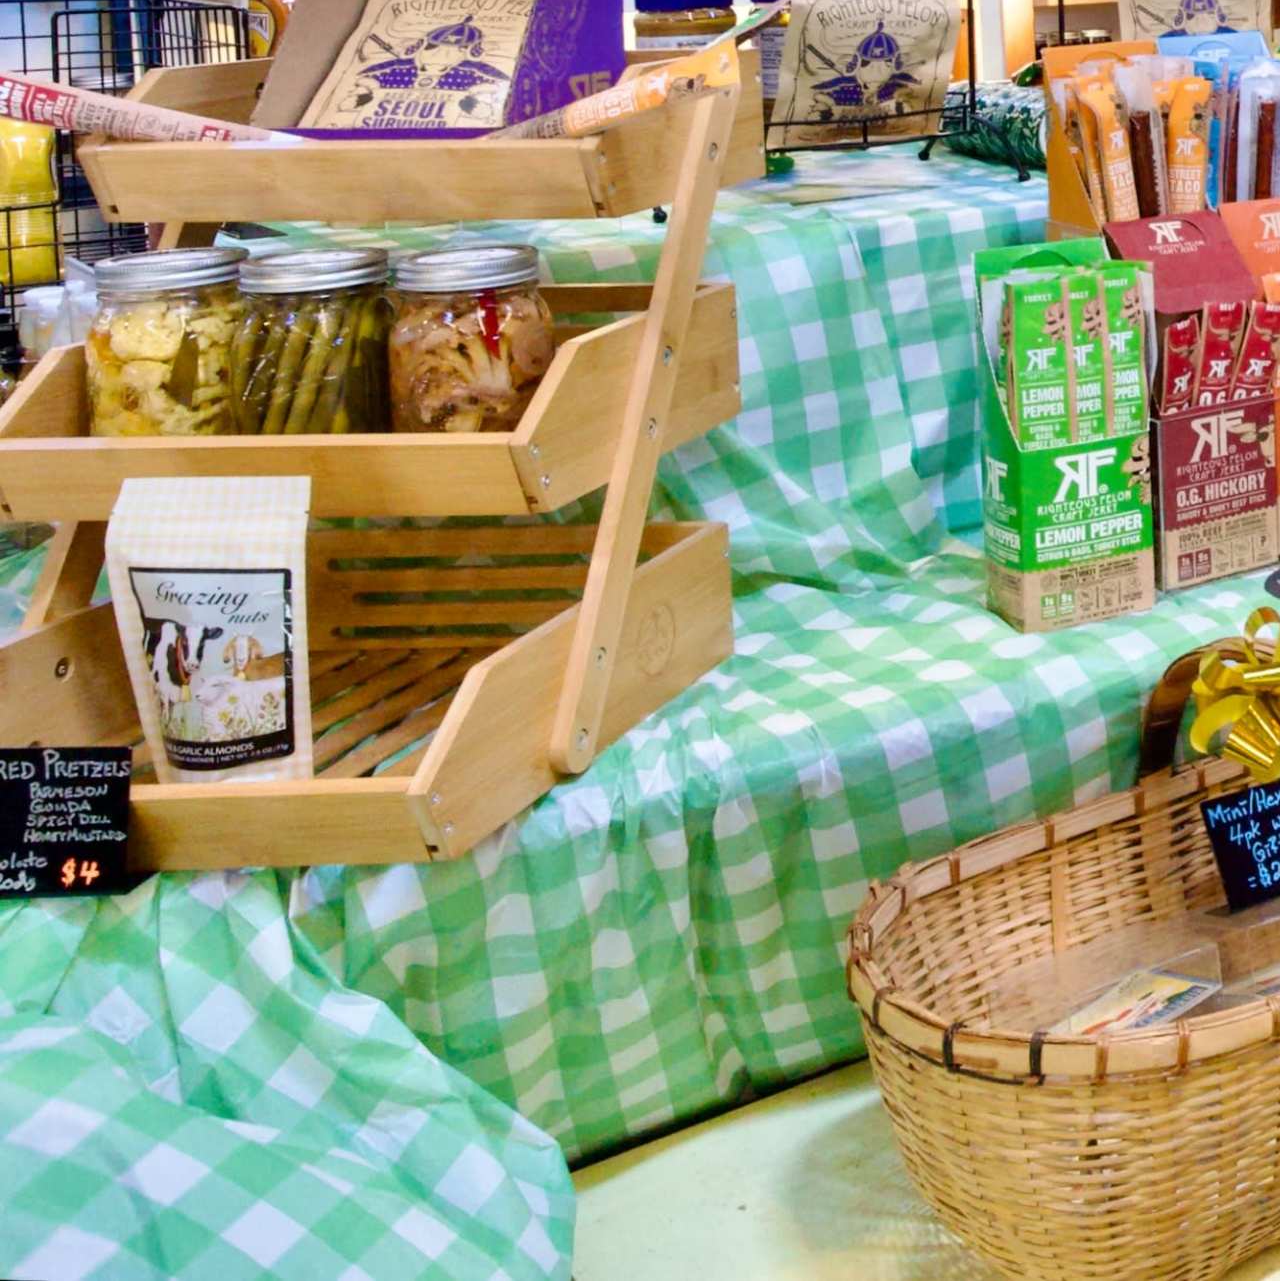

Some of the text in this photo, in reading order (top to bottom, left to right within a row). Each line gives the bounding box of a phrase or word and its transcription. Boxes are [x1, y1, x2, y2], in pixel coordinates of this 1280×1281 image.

[897, 0, 943, 26] FELON
[373, 99, 448, 119] SEOUL
[1169, 179, 1201, 193] TACO
[1022, 385, 1065, 403] LEMON
[1076, 382, 1101, 400] MON
[1023, 402, 1065, 419] PEPPER
[1077, 398, 1102, 414] PPER
[1177, 450, 1258, 476] RIGHTEOUS FELON
[1190, 464, 1245, 482] CRAFT JERKY
[1176, 472, 1267, 508] O.G. HICKORY
[1249, 493, 1267, 505] STICK
[1037, 490, 1132, 516] RIGHTEOUS FELON
[1052, 504, 1118, 523] CRAFT JERKY
[1035, 513, 1143, 549] LEMON PEPPER
[1179, 525, 1222, 542] 100% BEEF
[1071, 545, 1091, 557] BASIL
[1120, 534, 1141, 547] STICK
[156, 580, 250, 616] Grazing
[227, 611, 270, 625] nuts
[178, 742, 256, 756] GARLIC ALMONDS
[42, 749, 132, 780] PRETZELS
[30, 782, 108, 799] PARMESON
[30, 798, 92, 814] GOUDA
[26, 812, 111, 828] SPICY DILL
[61, 857, 100, 888] $4
